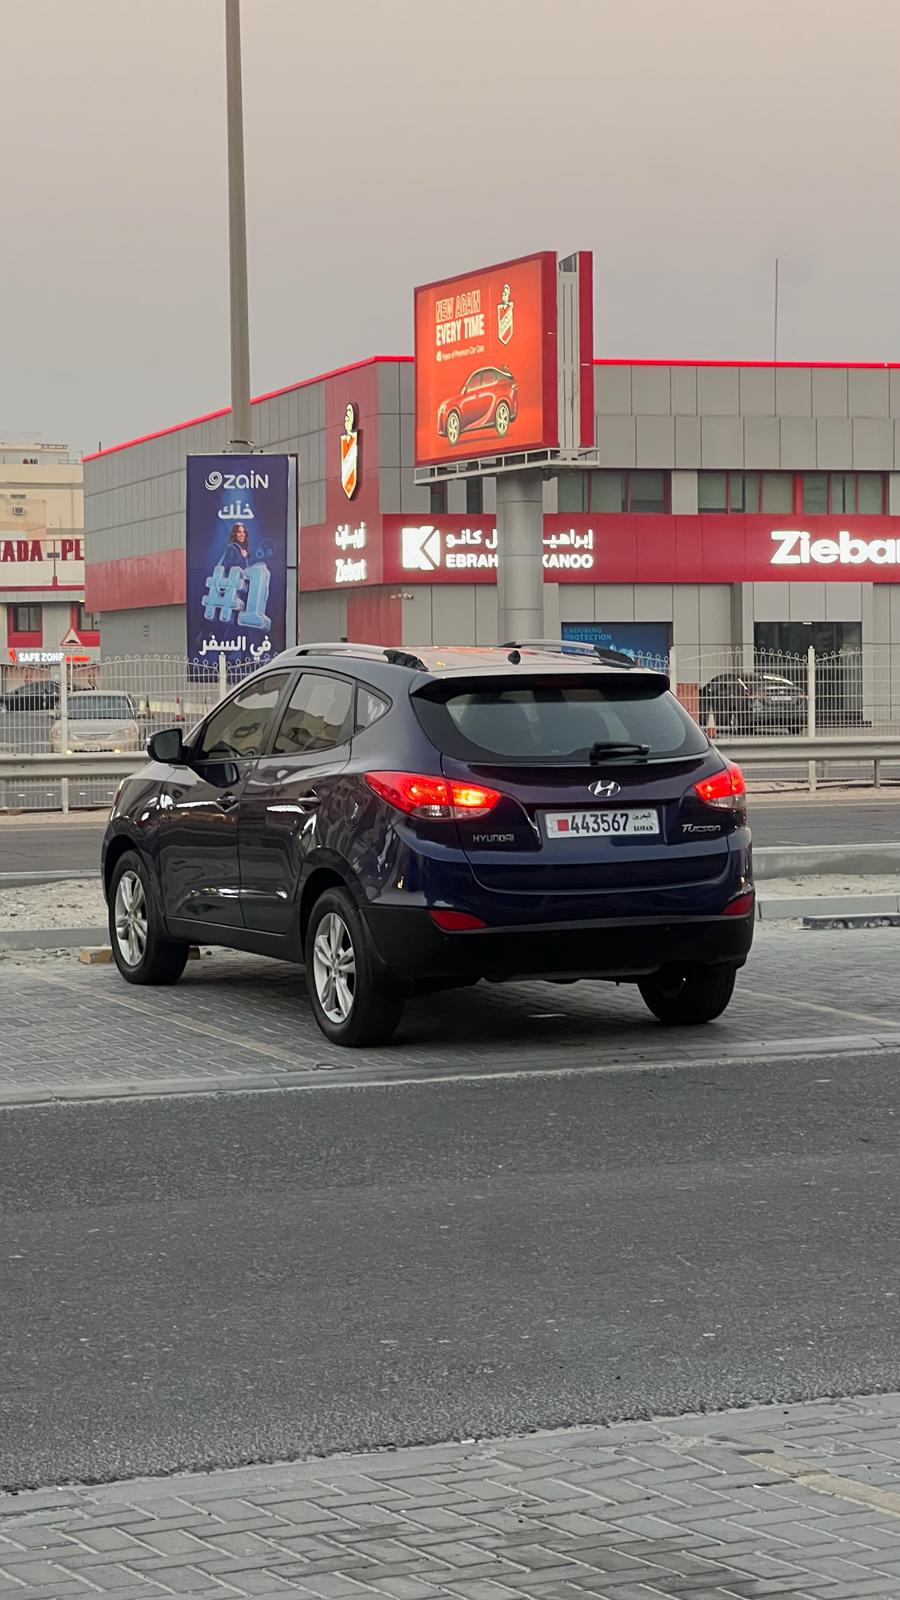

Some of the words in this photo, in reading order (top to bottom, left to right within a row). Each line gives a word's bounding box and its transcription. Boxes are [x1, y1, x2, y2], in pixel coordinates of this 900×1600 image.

[436, 296, 454, 323] NEW
[455, 289, 481, 319] AGAIN
[436, 319, 462, 346] EVERY
[463, 313, 485, 339] TIME
[445, 528, 482, 548] كانو
[542, 528, 594, 550] إبراهي
[0, 539, 43, 562] ADA
[61, 539, 84, 560] PL
[445, 553, 499, 568] EBRAH
[201, 562, 271, 632] #1
[199, 635, 246, 655] السفر
[249, 635, 272, 660] في
[18, 653, 40, 662] SAFE
[570, 813, 629, 834] 443567
[472, 833, 515, 843] HYUNDAI
